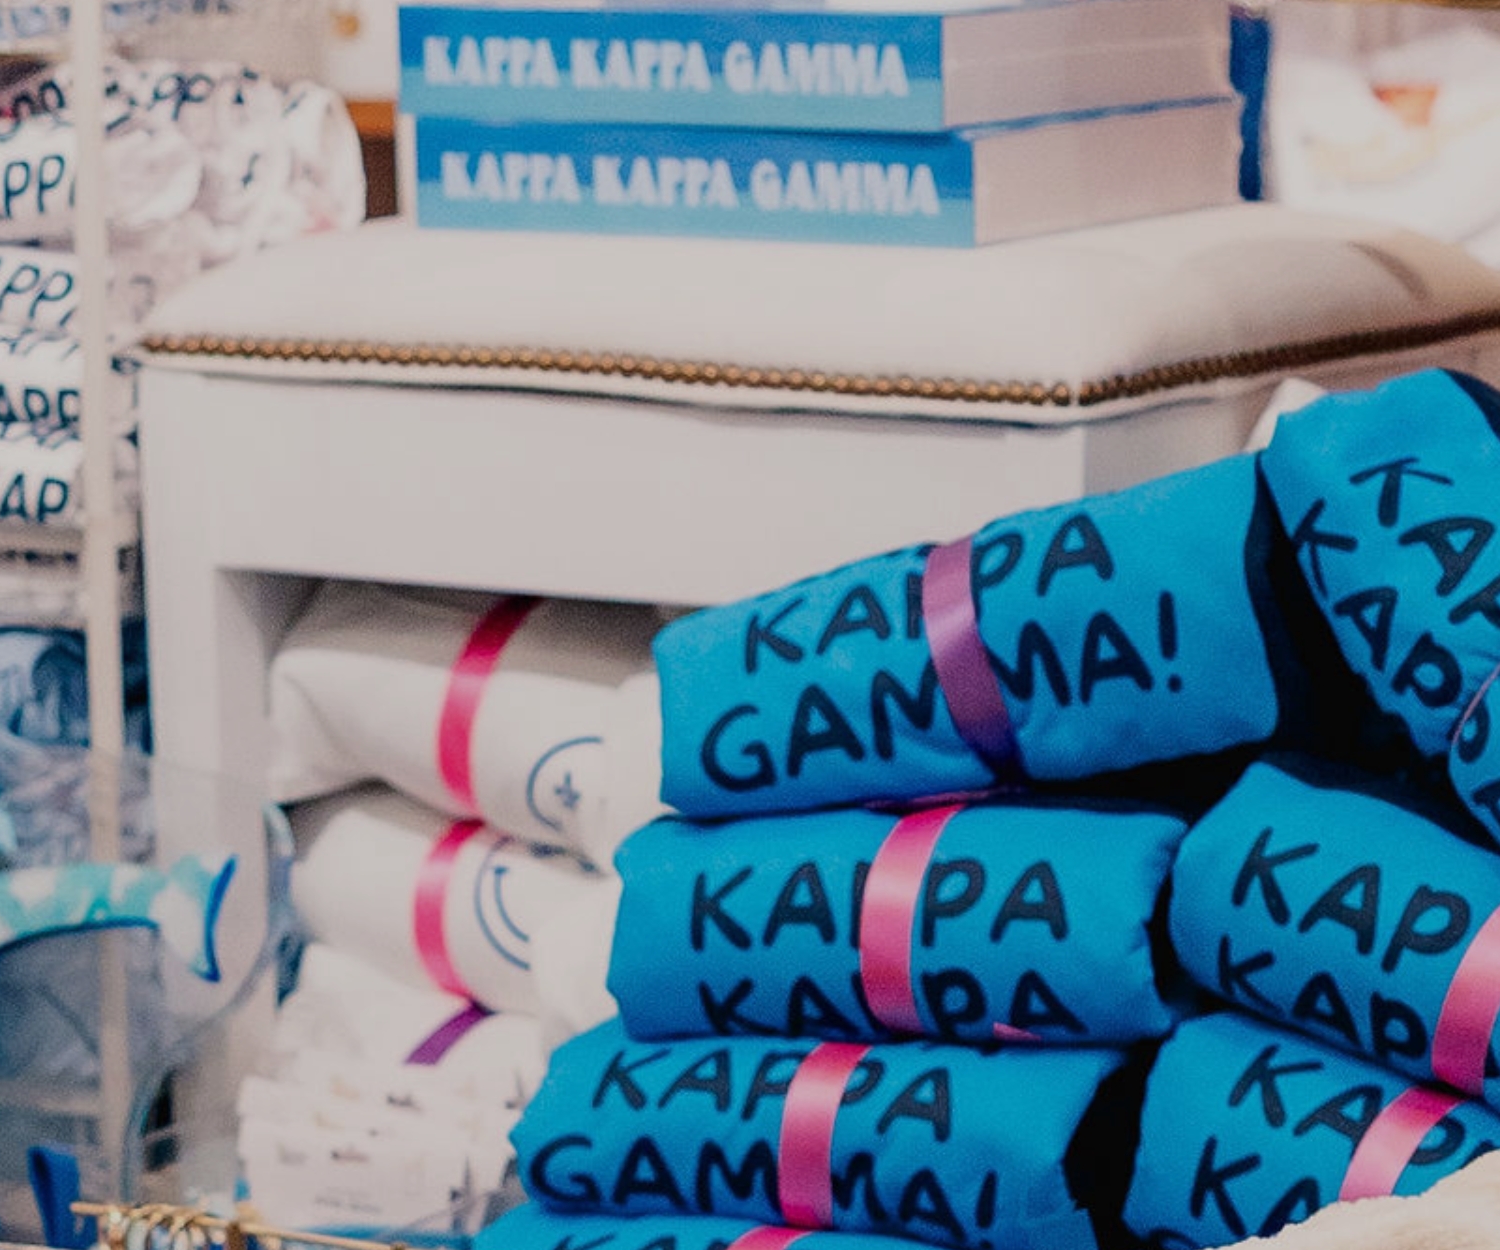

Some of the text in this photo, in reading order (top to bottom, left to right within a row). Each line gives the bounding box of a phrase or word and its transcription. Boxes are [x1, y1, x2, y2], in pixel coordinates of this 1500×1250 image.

[423, 35, 909, 98] KAPPA KAPPA GAMMA
[440, 150, 940, 216] KAPPA KAPPA GAMMA
